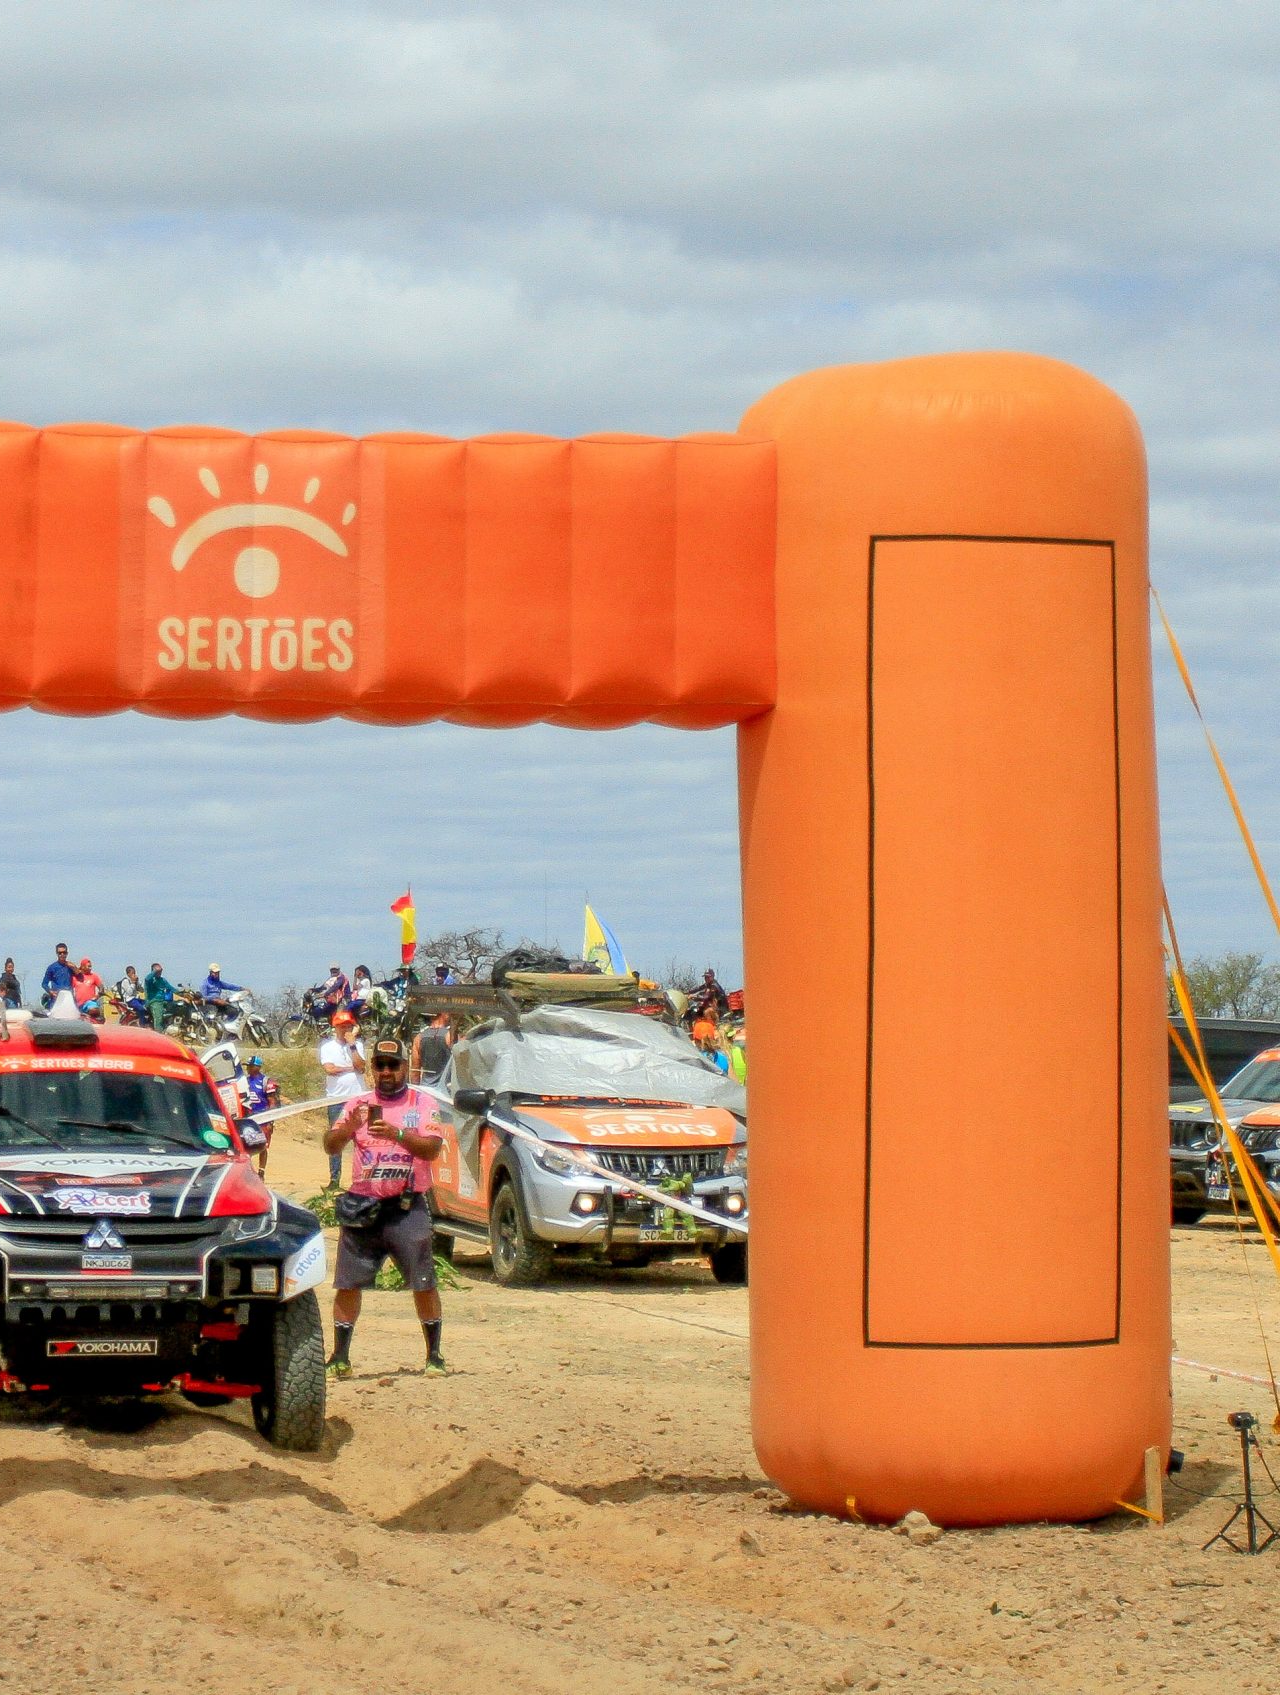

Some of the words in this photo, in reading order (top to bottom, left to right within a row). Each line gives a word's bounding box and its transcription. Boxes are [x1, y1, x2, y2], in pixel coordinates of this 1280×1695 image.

[34, 1158, 195, 1168] YOKOHAMA
[60, 1190, 151, 1209] Accert
[295, 1248, 320, 1277] atvos
[76, 1342, 152, 1353] YOKOHAMA
